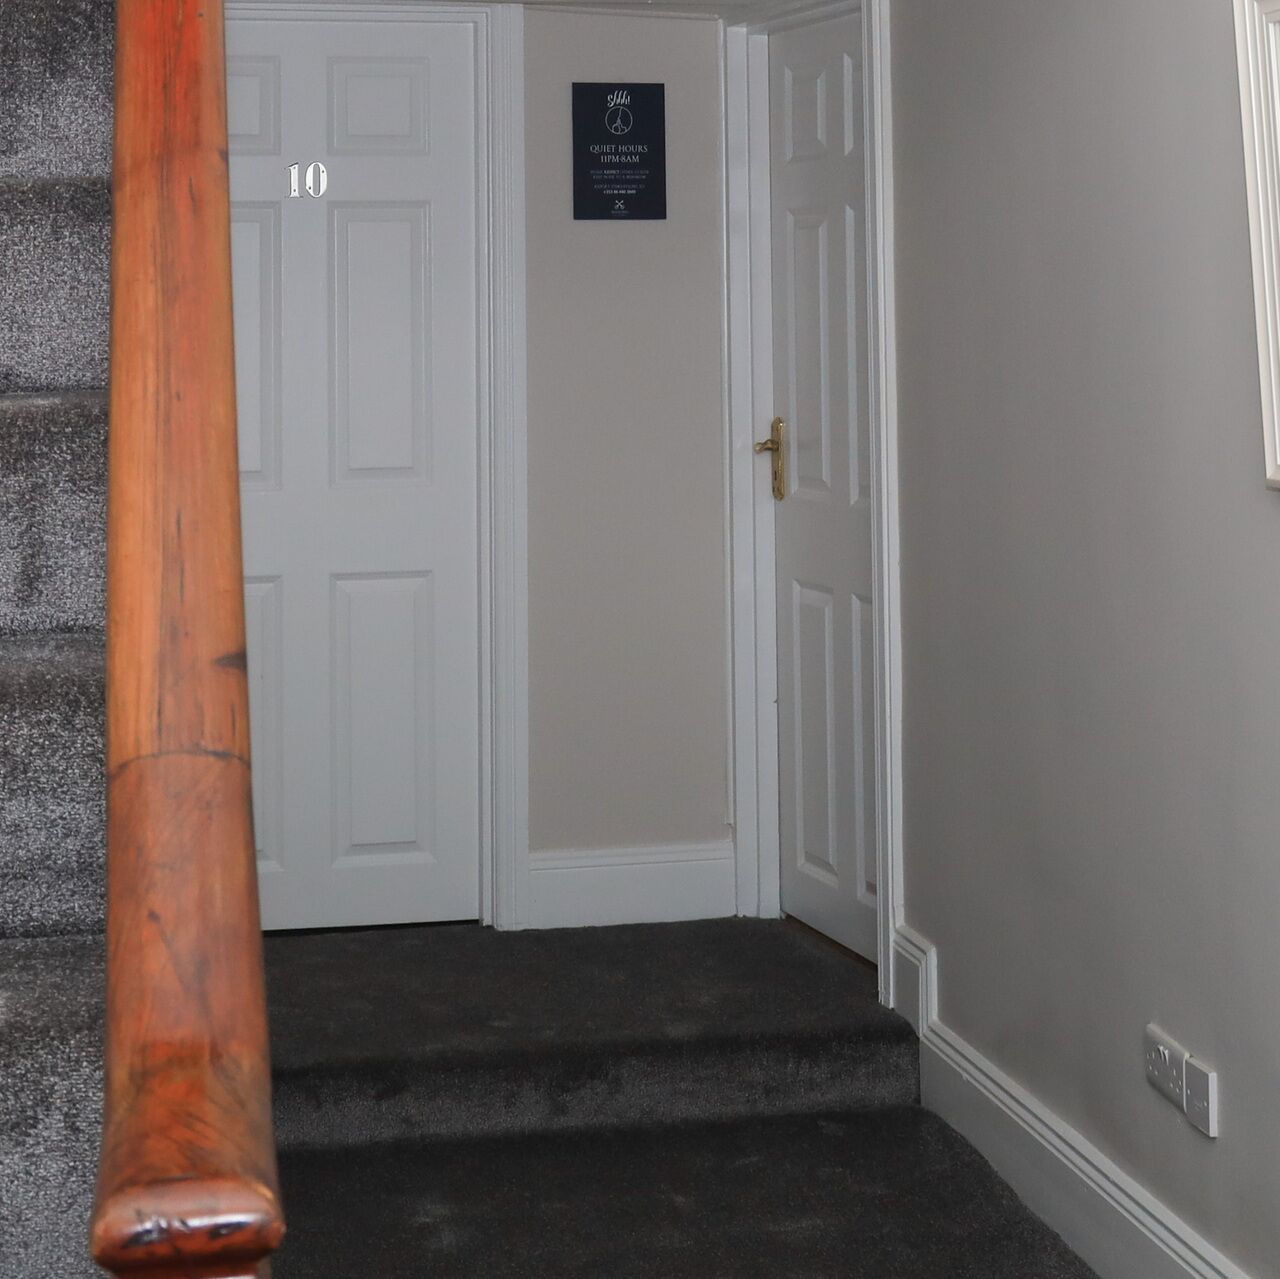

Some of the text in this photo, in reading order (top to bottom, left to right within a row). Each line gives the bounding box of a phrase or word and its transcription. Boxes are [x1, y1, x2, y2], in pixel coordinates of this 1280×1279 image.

[589, 144, 648, 154] QUIET HOURS
[600, 154, 640, 163] 11PM-8AM
[286, 161, 328, 198] 10
